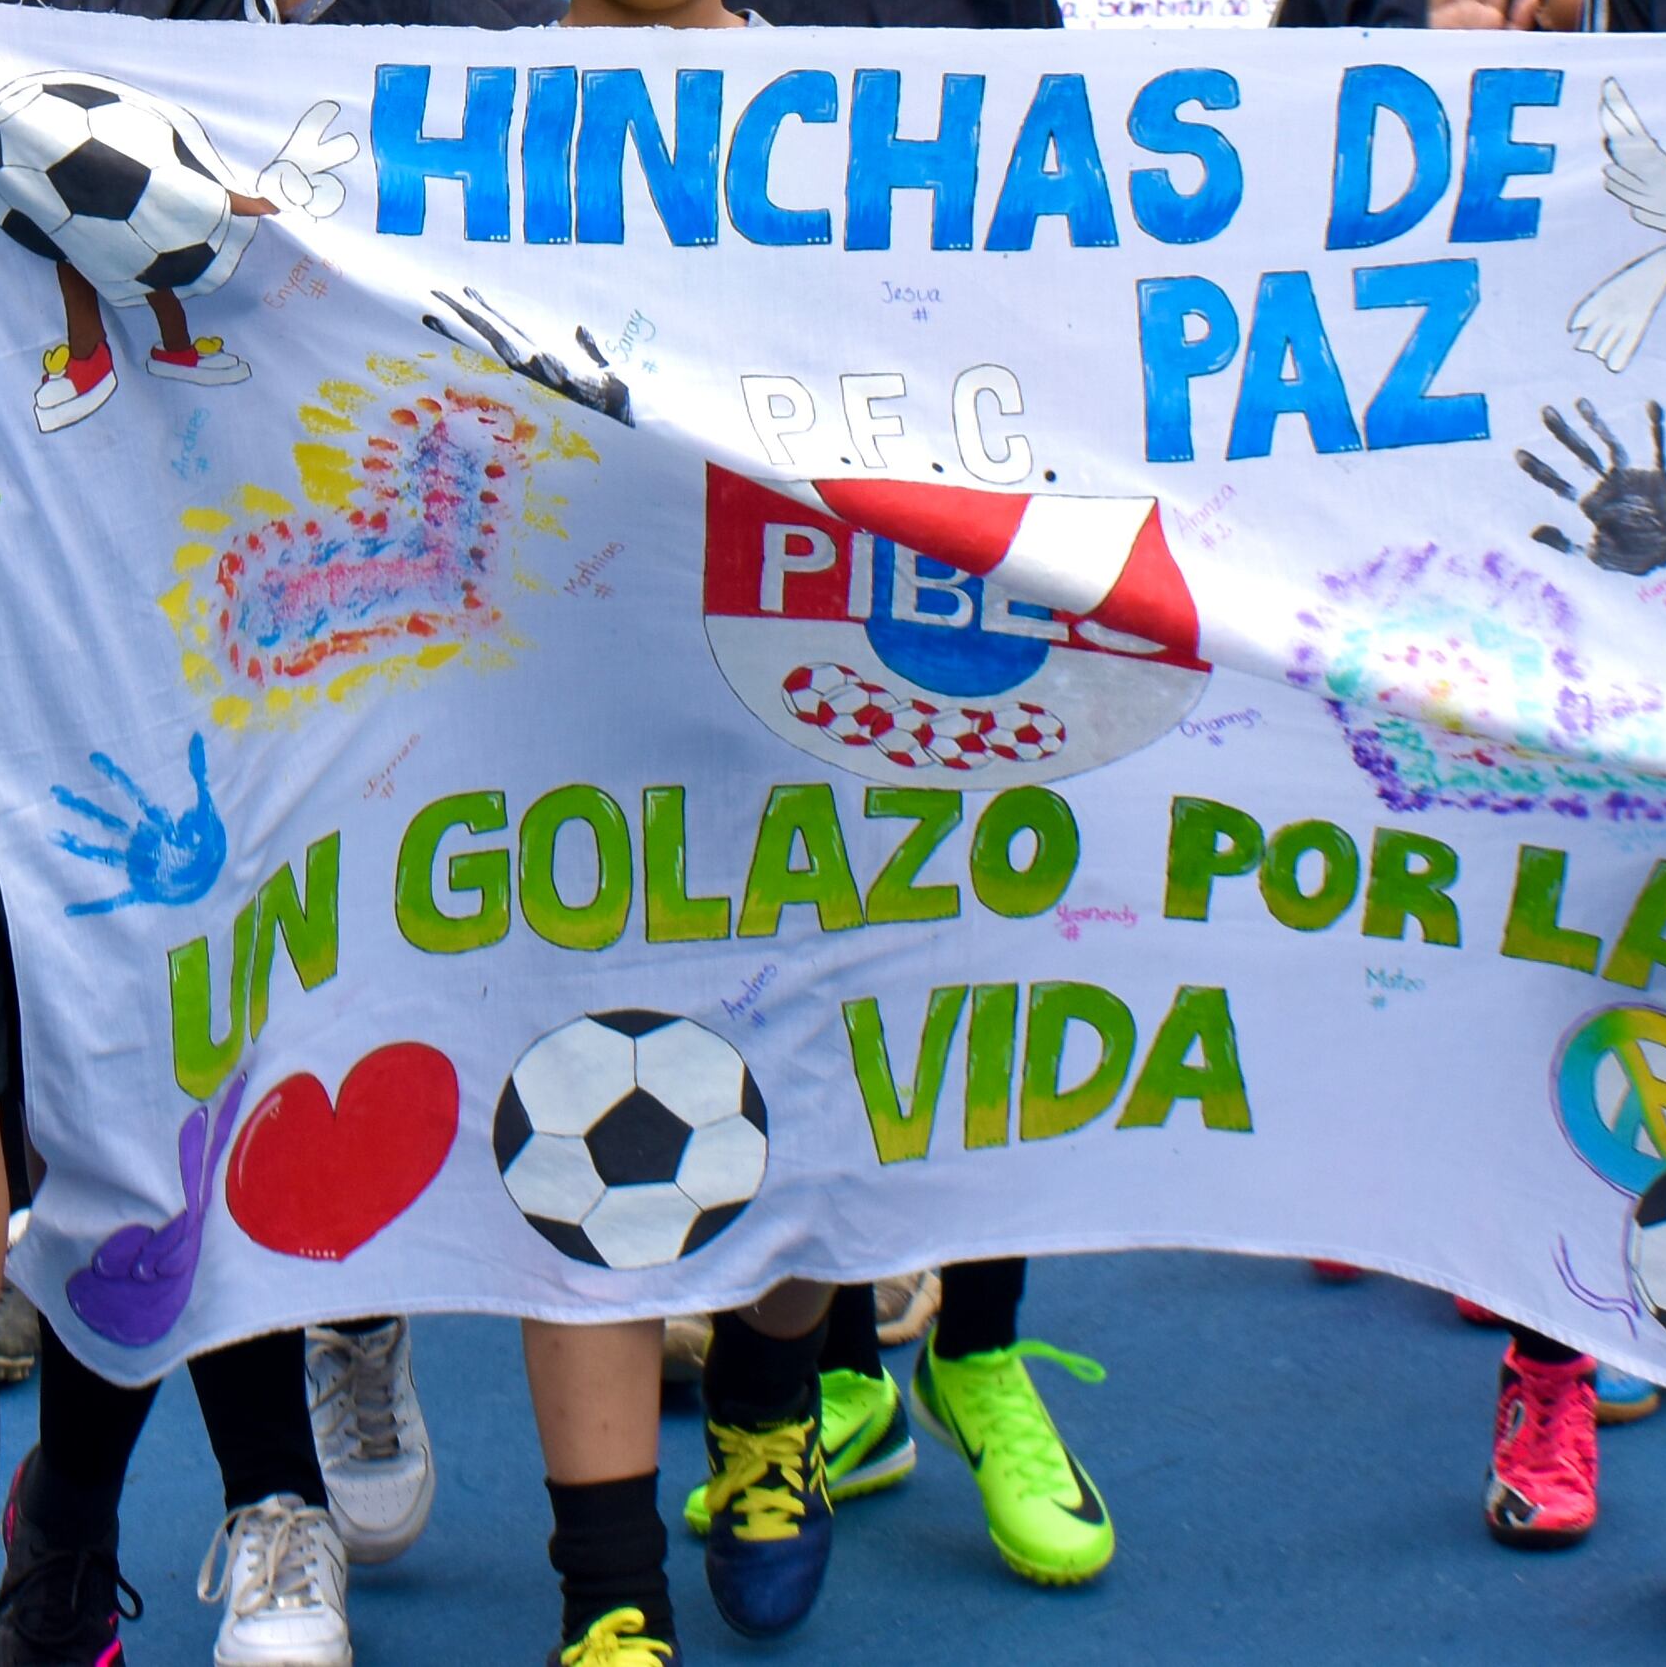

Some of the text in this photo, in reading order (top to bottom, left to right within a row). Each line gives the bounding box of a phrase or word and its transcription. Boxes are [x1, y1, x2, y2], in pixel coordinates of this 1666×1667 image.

[369, 62, 1566, 253] HINCHAS DE
[739, 363, 1058, 486] P.F.C.
[1136, 257, 1492, 464] PAZ
[759, 521, 1169, 655] PIBE
[169, 832, 340, 1100] UN
[394, 783, 1078, 954] GOLAZO
[1163, 798, 1459, 946] POR
[842, 981, 1251, 1165] VIDA
